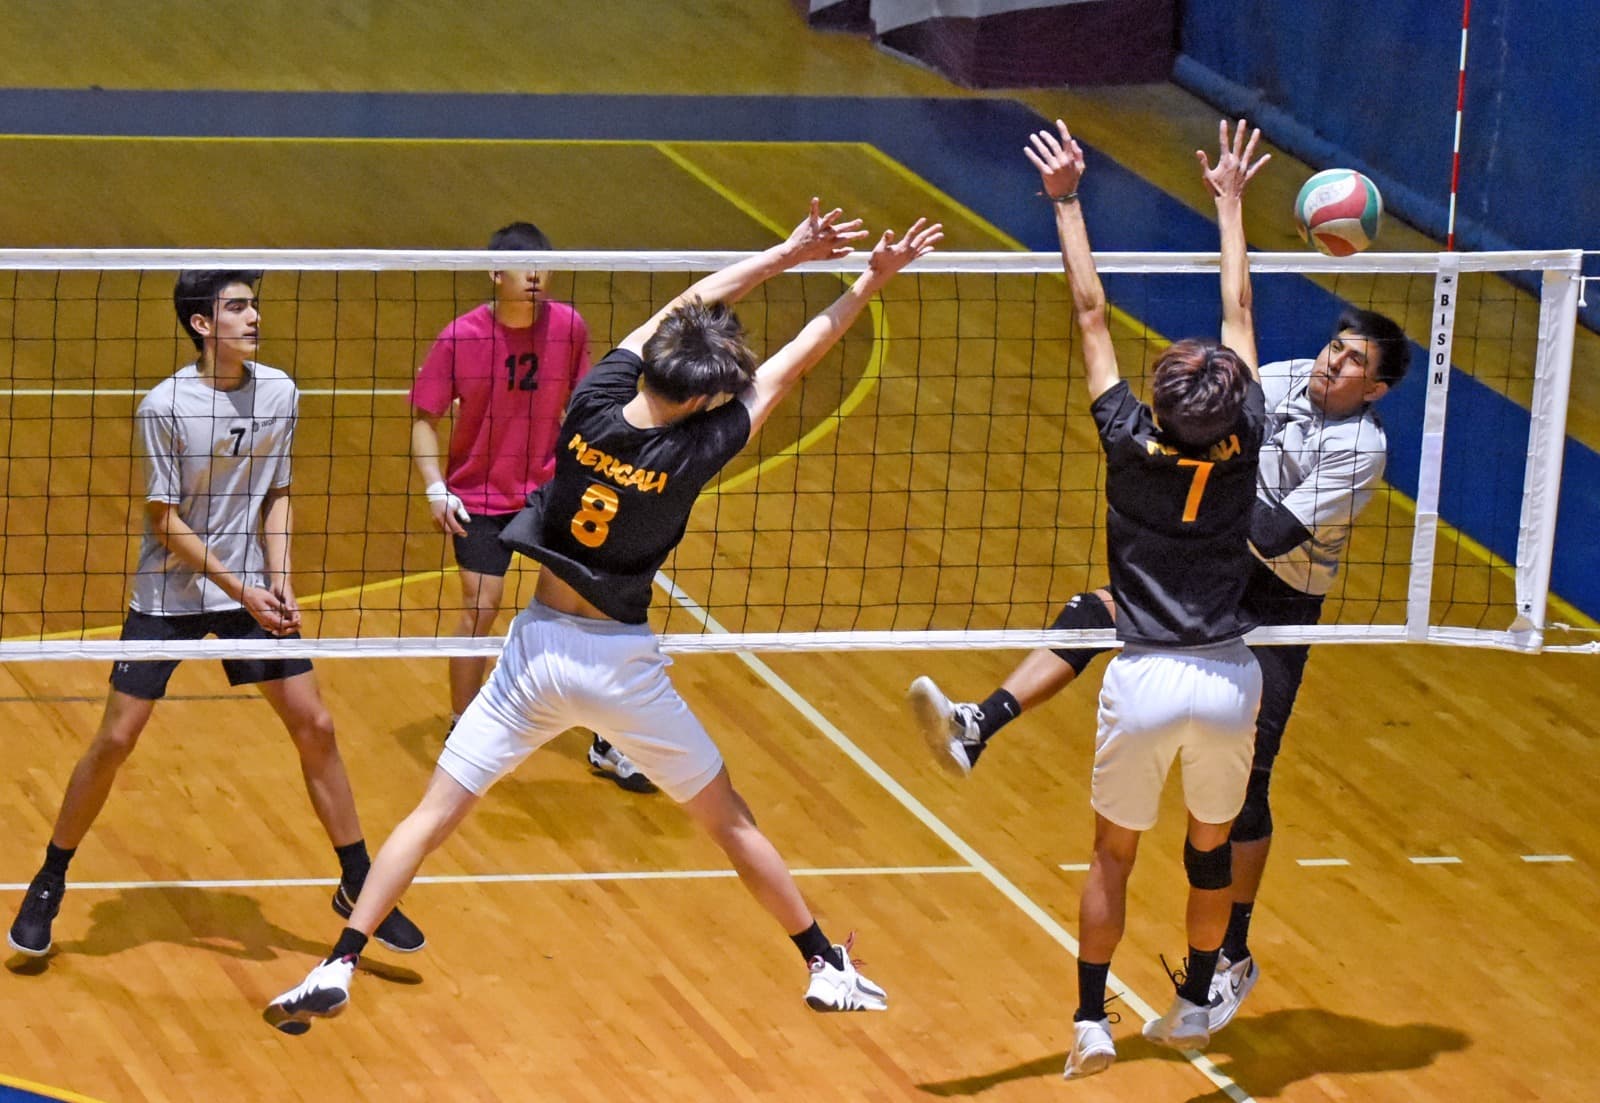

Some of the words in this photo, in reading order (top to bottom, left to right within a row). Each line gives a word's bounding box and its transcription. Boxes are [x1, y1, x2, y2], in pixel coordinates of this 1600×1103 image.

[1434, 294, 1449, 385] BISON
[505, 354, 538, 391] 12
[230, 427, 246, 456] 7
[568, 433, 668, 493] MEXICALI
[571, 483, 619, 548] 8
[1177, 458, 1215, 522] 7
